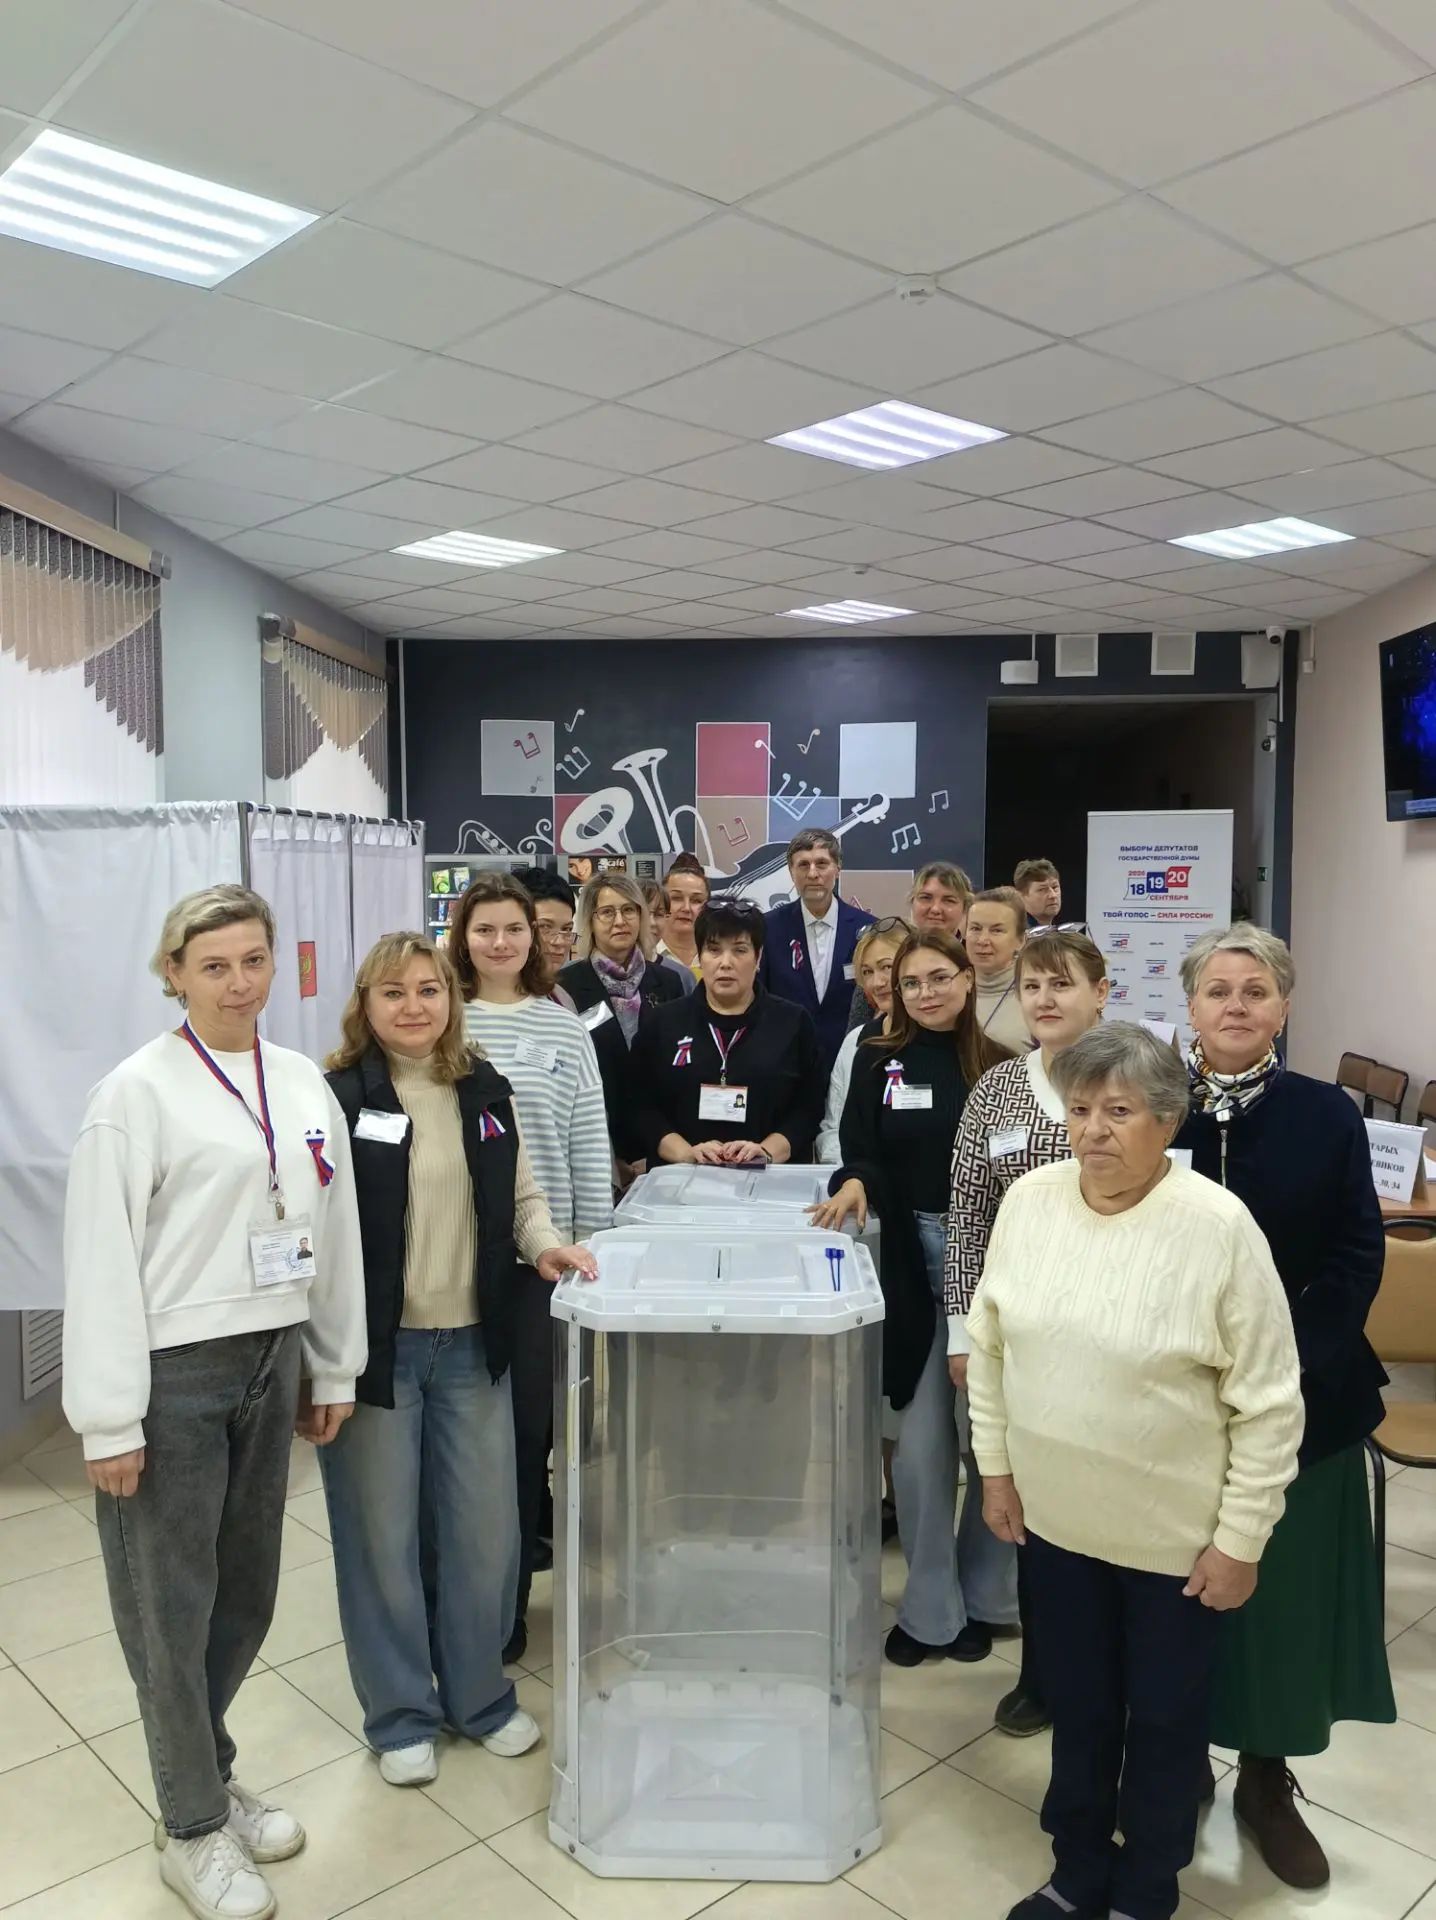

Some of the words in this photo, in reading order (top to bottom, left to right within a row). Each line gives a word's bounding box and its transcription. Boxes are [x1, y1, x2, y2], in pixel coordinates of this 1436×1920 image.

[1130, 884, 1145, 895] 18
[1149, 877, 1164, 889] 19
[1168, 871, 1187, 883] 20
